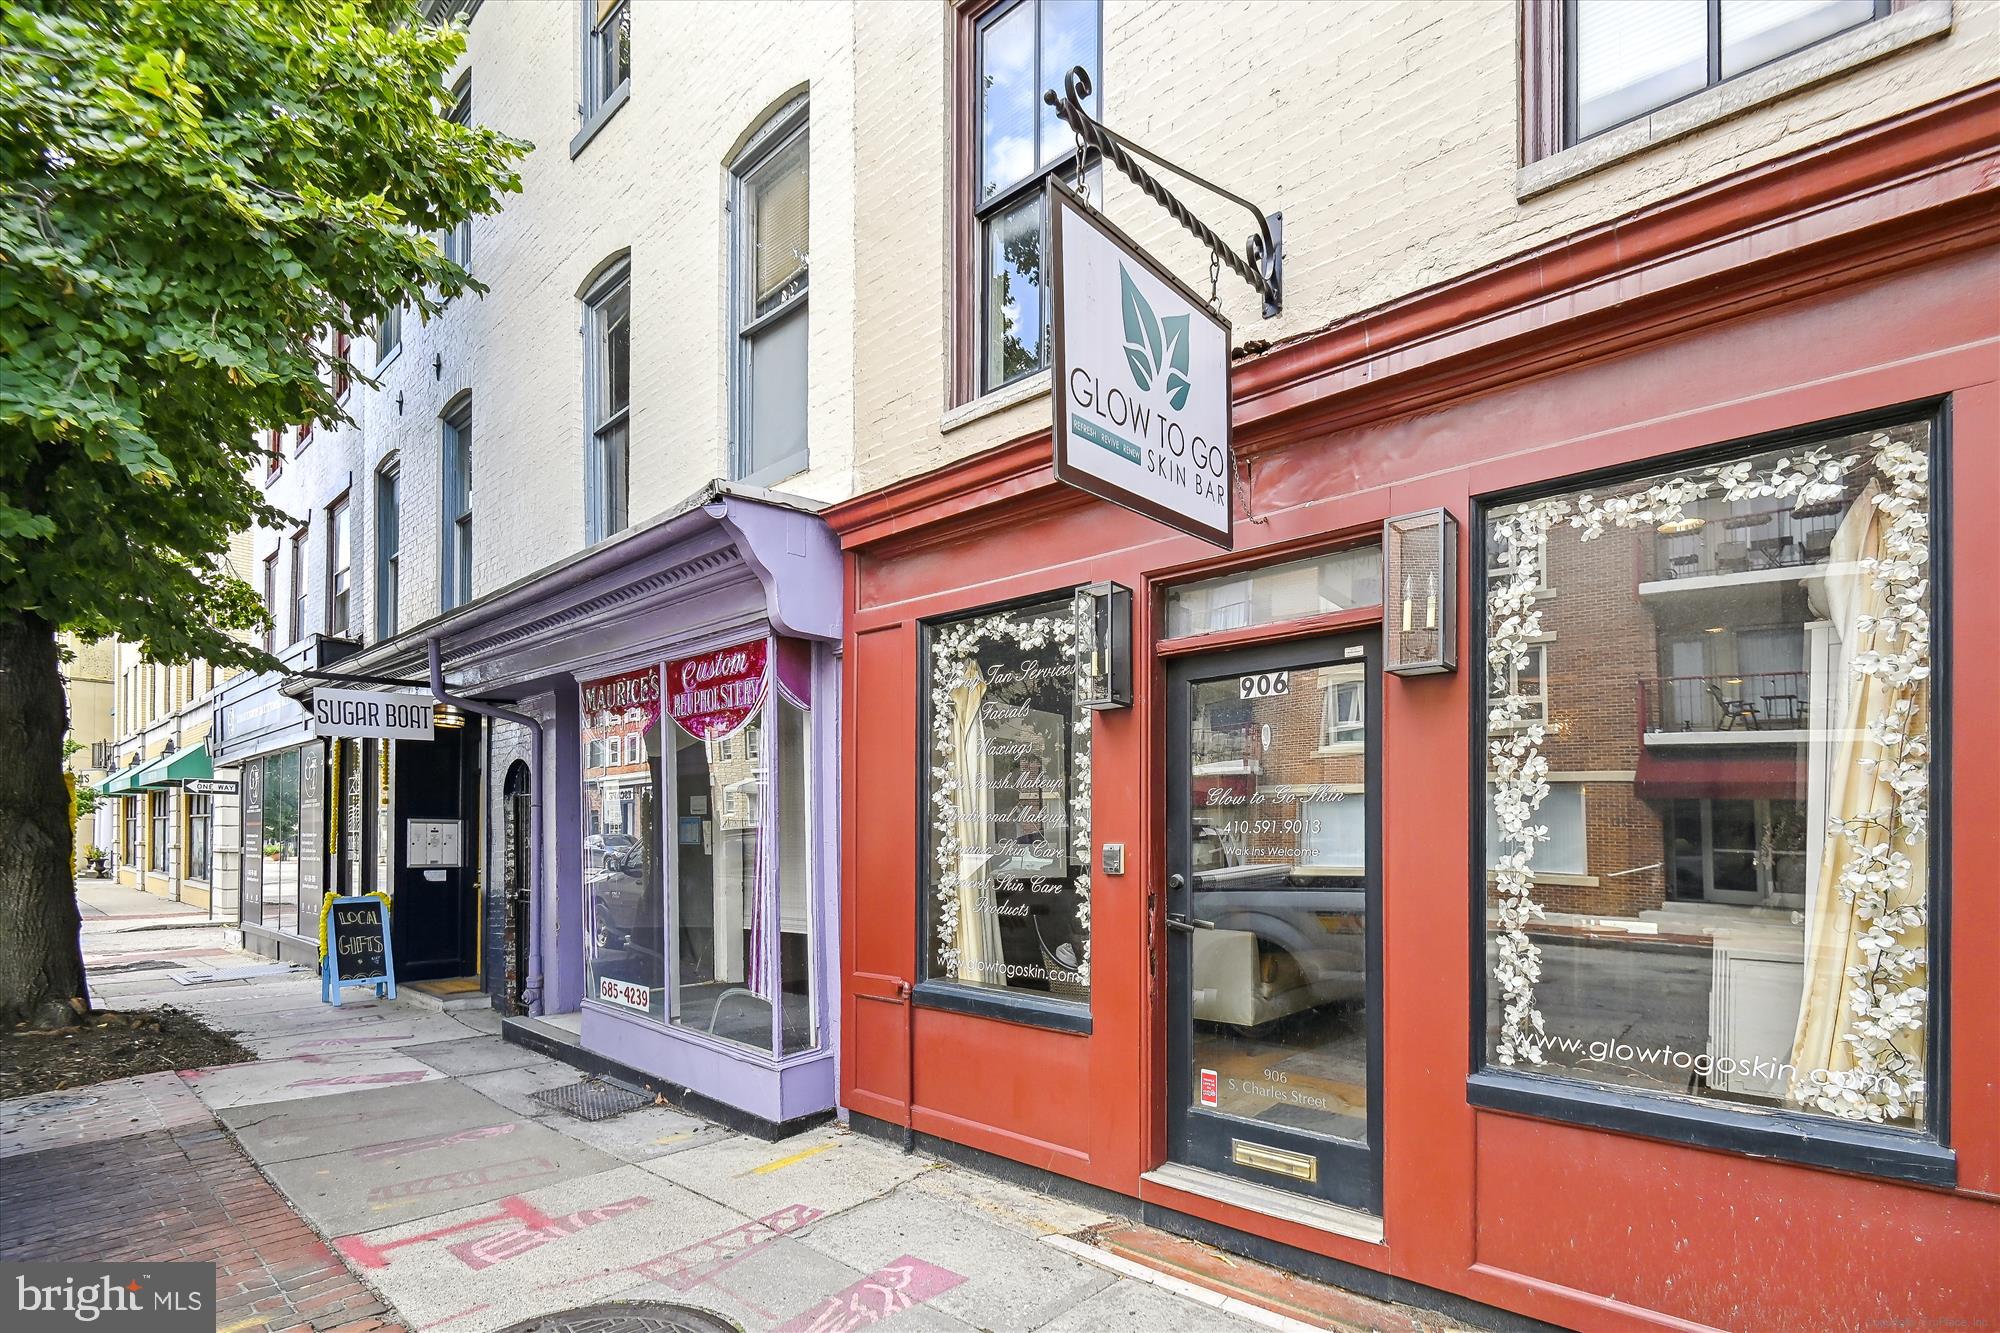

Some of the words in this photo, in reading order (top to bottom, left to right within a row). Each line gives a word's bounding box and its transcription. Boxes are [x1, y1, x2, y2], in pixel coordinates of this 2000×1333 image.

[1070, 368, 1150, 438] GLOW
[1157, 413, 1186, 457] TO
[1192, 436, 1224, 478] GO
[1073, 420, 1097, 438] REFRESH
[1101, 433, 1120, 450] REVIVE
[1122, 444, 1140, 459] RENEW
[1147, 449, 1186, 488] SKIN
[1195, 473, 1225, 506] BAR
[682, 650, 749, 689] Custom
[984, 664, 1013, 686] Tan
[1016, 659, 1077, 682] Services
[585, 668, 660, 711] MAURICE'S
[674, 677, 760, 718] REUPHOLSTERY
[1241, 672, 1287, 698] 906
[317, 698, 380, 727] SUGAR
[386, 702, 432, 730] BOAT
[981, 697, 1031, 721] Facials
[976, 737, 1033, 761] Waxings
[1011, 770, 1064, 793] Makeup
[1206, 787, 1246, 806] Glow
[1250, 792, 1266, 805] to
[1272, 784, 1296, 804] Go
[1300, 783, 1345, 804] Skin
[1013, 804, 1066, 829] Makeup
[1223, 819, 1322, 835] 410.591.9013
[993, 838, 1026, 856] Skin
[1032, 839, 1065, 859] Care
[1225, 846, 1250, 857] Walk
[1251, 847, 1266, 857] Ins
[1267, 846, 1320, 857] Welcome
[992, 873, 1025, 892] Skin
[1030, 874, 1063, 894] Care
[338, 910, 382, 925] LOCAL
[973, 897, 1030, 917] Products
[338, 935, 384, 955] GIFTS
[601, 980, 648, 1007] 685-4239
[1512, 1029, 1898, 1097] www.glowtogoskin.com
[1264, 1069, 1287, 1084] 906
[1228, 1078, 1239, 1091] S.
[1243, 1081, 1287, 1101] Charles
[1291, 1090, 1327, 1109] Street
